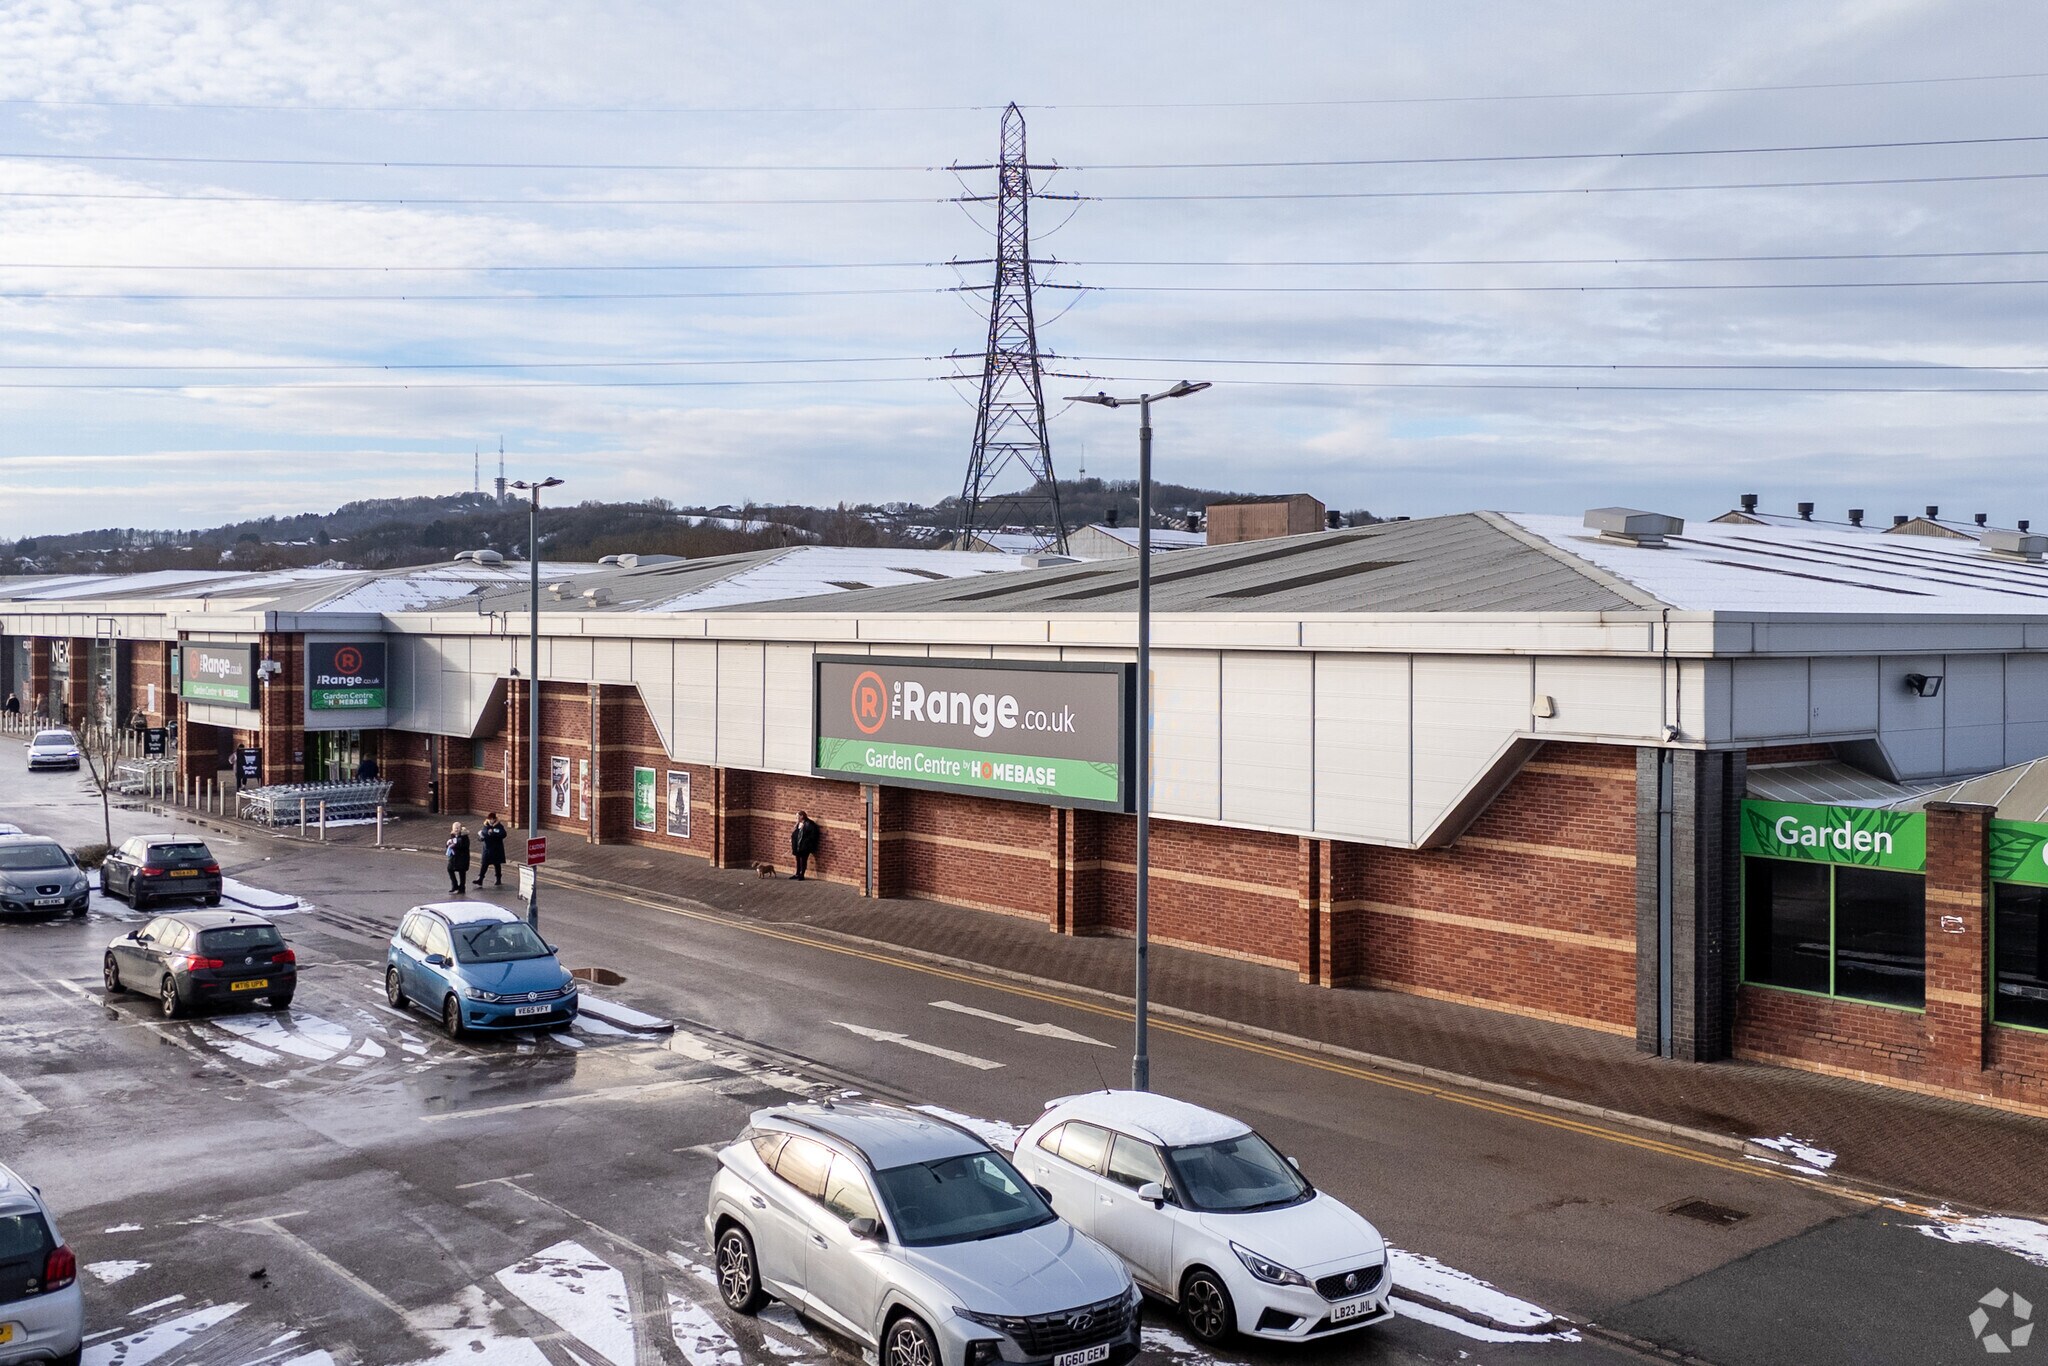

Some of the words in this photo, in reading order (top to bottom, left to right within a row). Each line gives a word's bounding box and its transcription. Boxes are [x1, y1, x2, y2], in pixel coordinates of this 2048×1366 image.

[892, 680, 902, 719] The
[866, 748, 912, 771] Garden
[914, 752, 960, 776] Centre
[962, 760, 970, 770] by
[971, 760, 1056, 786] HOMEBASE
[1776, 816, 1892, 854] Garden
[1334, 1304, 1355, 1319] LB23
[1358, 1300, 1372, 1313] JHL
[1060, 1352, 1084, 1366] AG60
[1088, 1346, 1106, 1361] GEM
